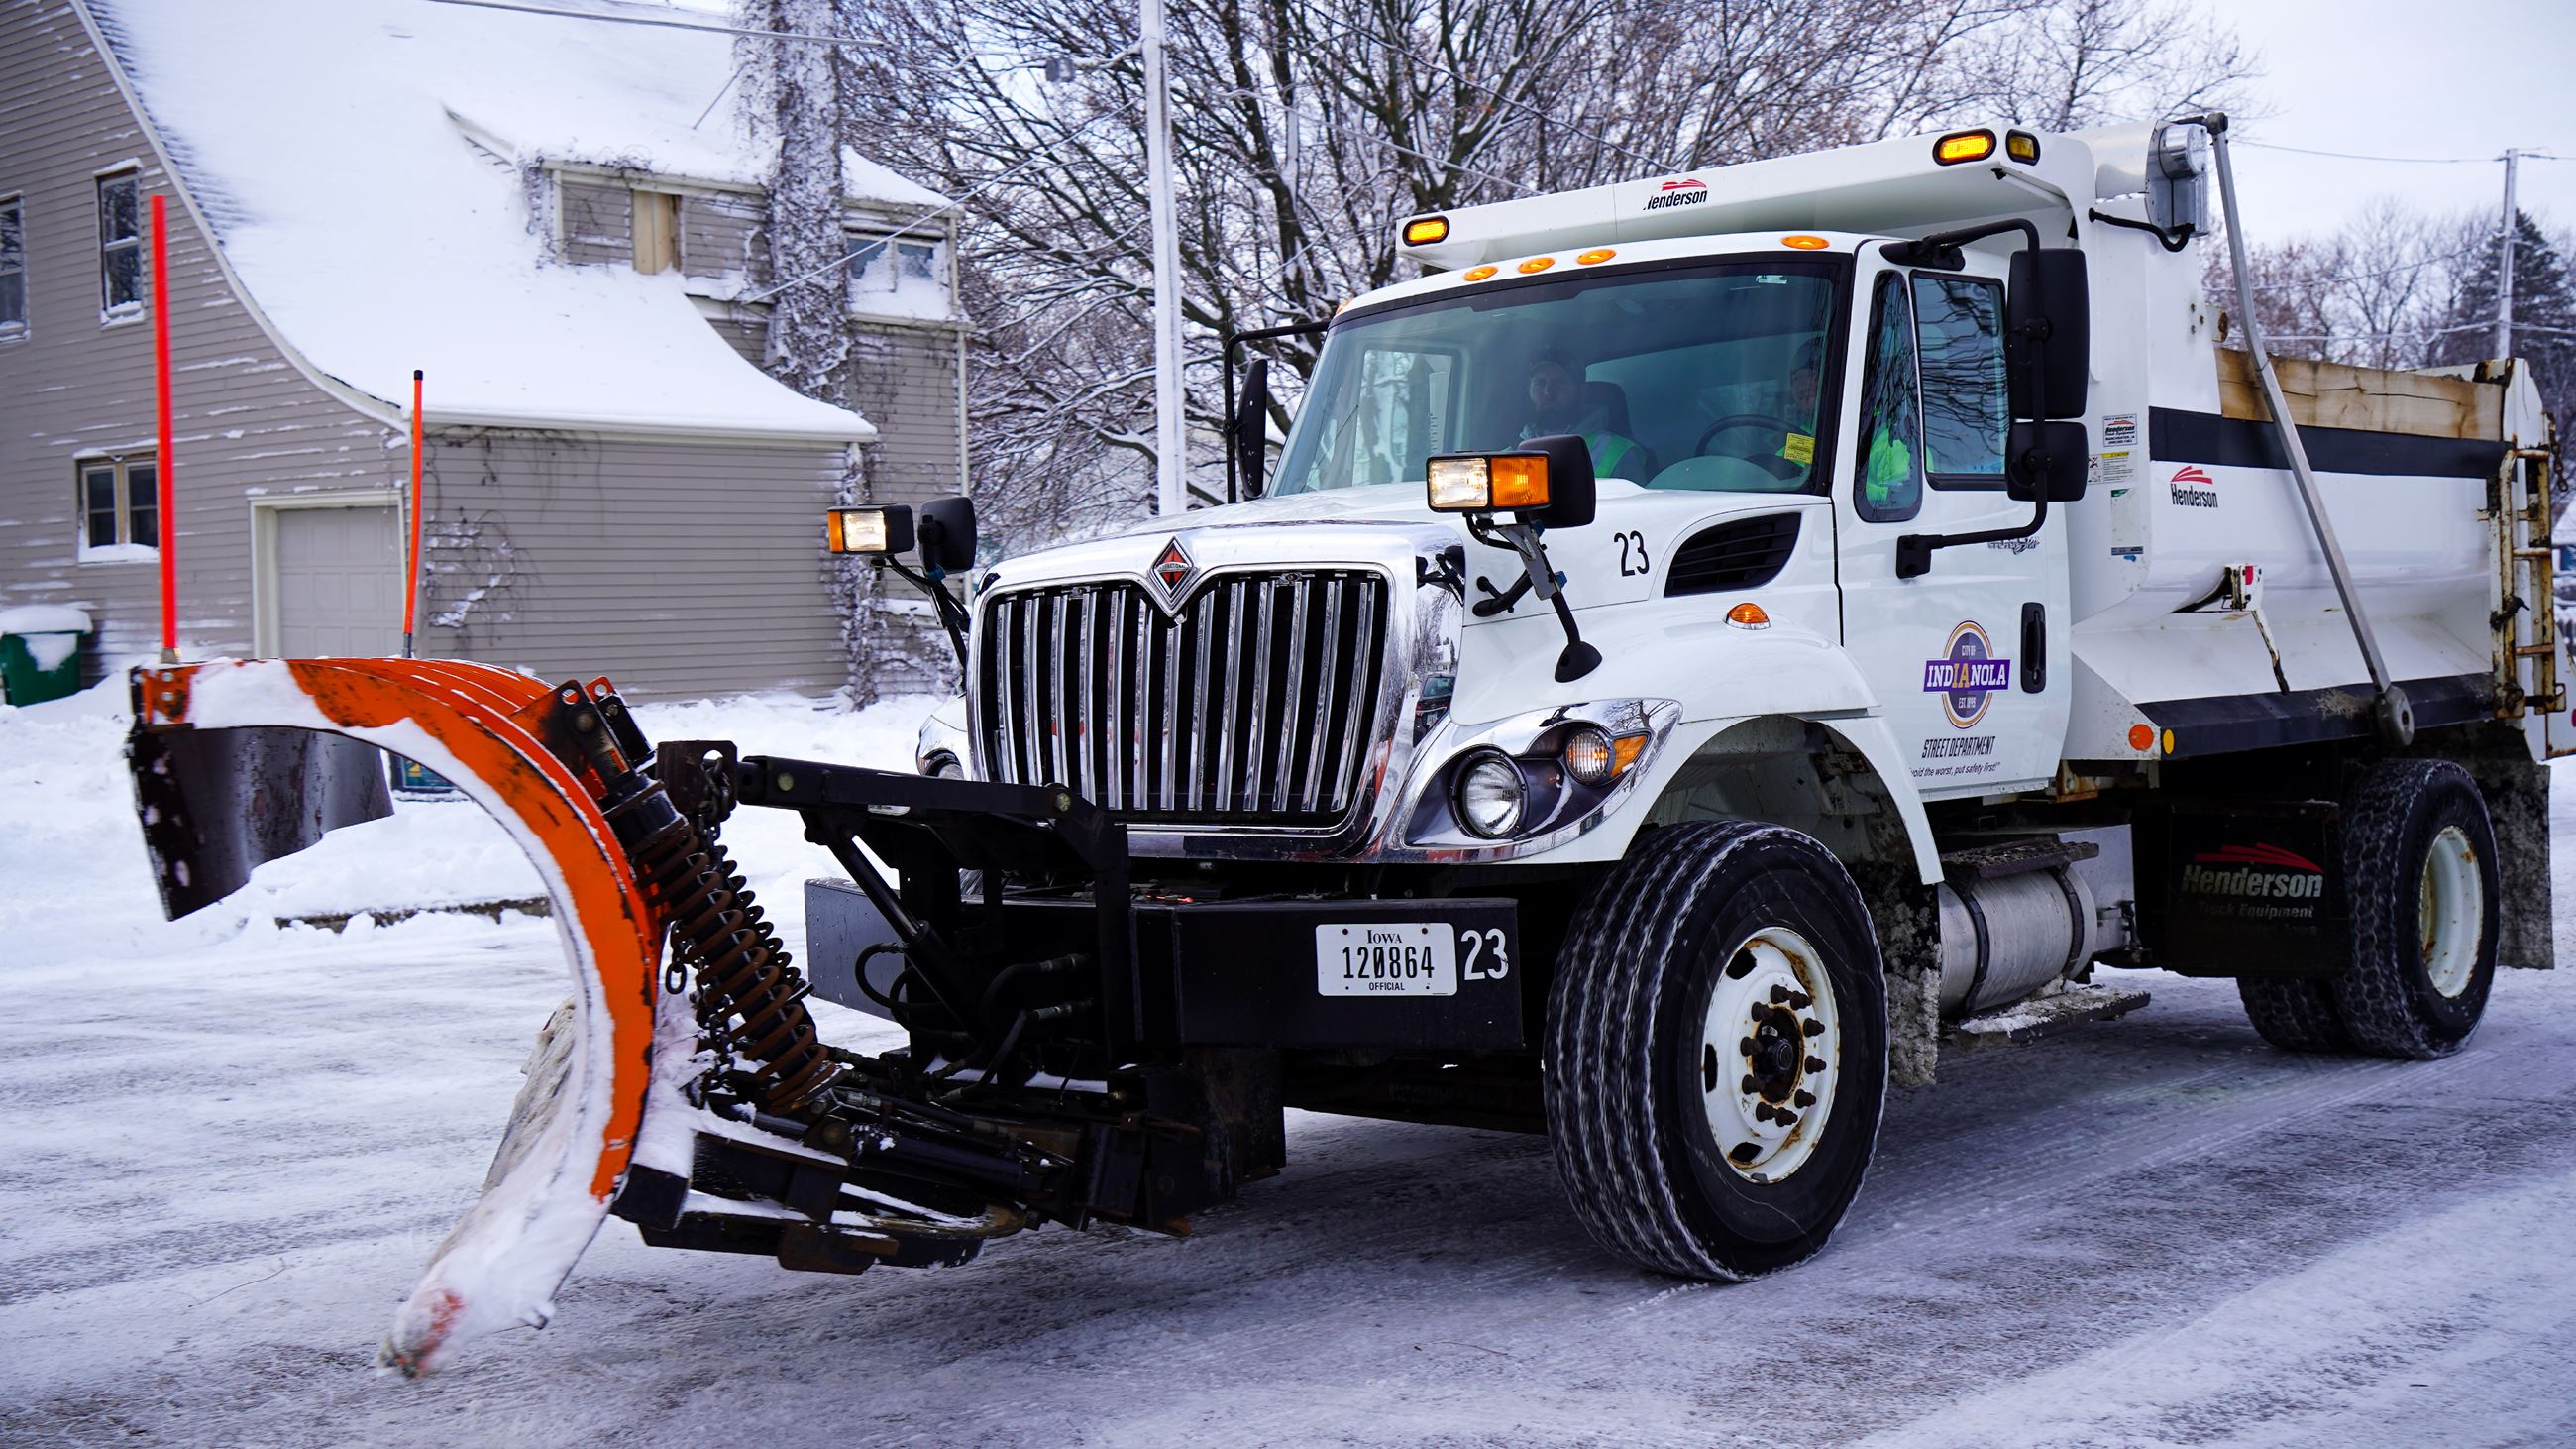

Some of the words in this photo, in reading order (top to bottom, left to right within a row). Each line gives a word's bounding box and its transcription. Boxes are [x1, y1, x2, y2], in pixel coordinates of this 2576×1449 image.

[2171, 483, 2218, 508] Henderson
[1613, 530, 1650, 577] 23
[1926, 663, 2006, 689] INDIANOLA
[1922, 738, 1951, 759] STREET
[1949, 735, 1996, 758] DEPARTMENT
[1924, 767, 1934, 777] the
[1935, 767, 1953, 777] worst,
[1954, 765, 1966, 777] put
[1966, 763, 1983, 775] safety
[2181, 864, 2324, 898] Henderson
[2238, 903, 2315, 920] Equipment
[1342, 946, 1435, 979] 120864
[1460, 928, 1510, 981] 23
[1368, 981, 1406, 991] OFFICIAL
